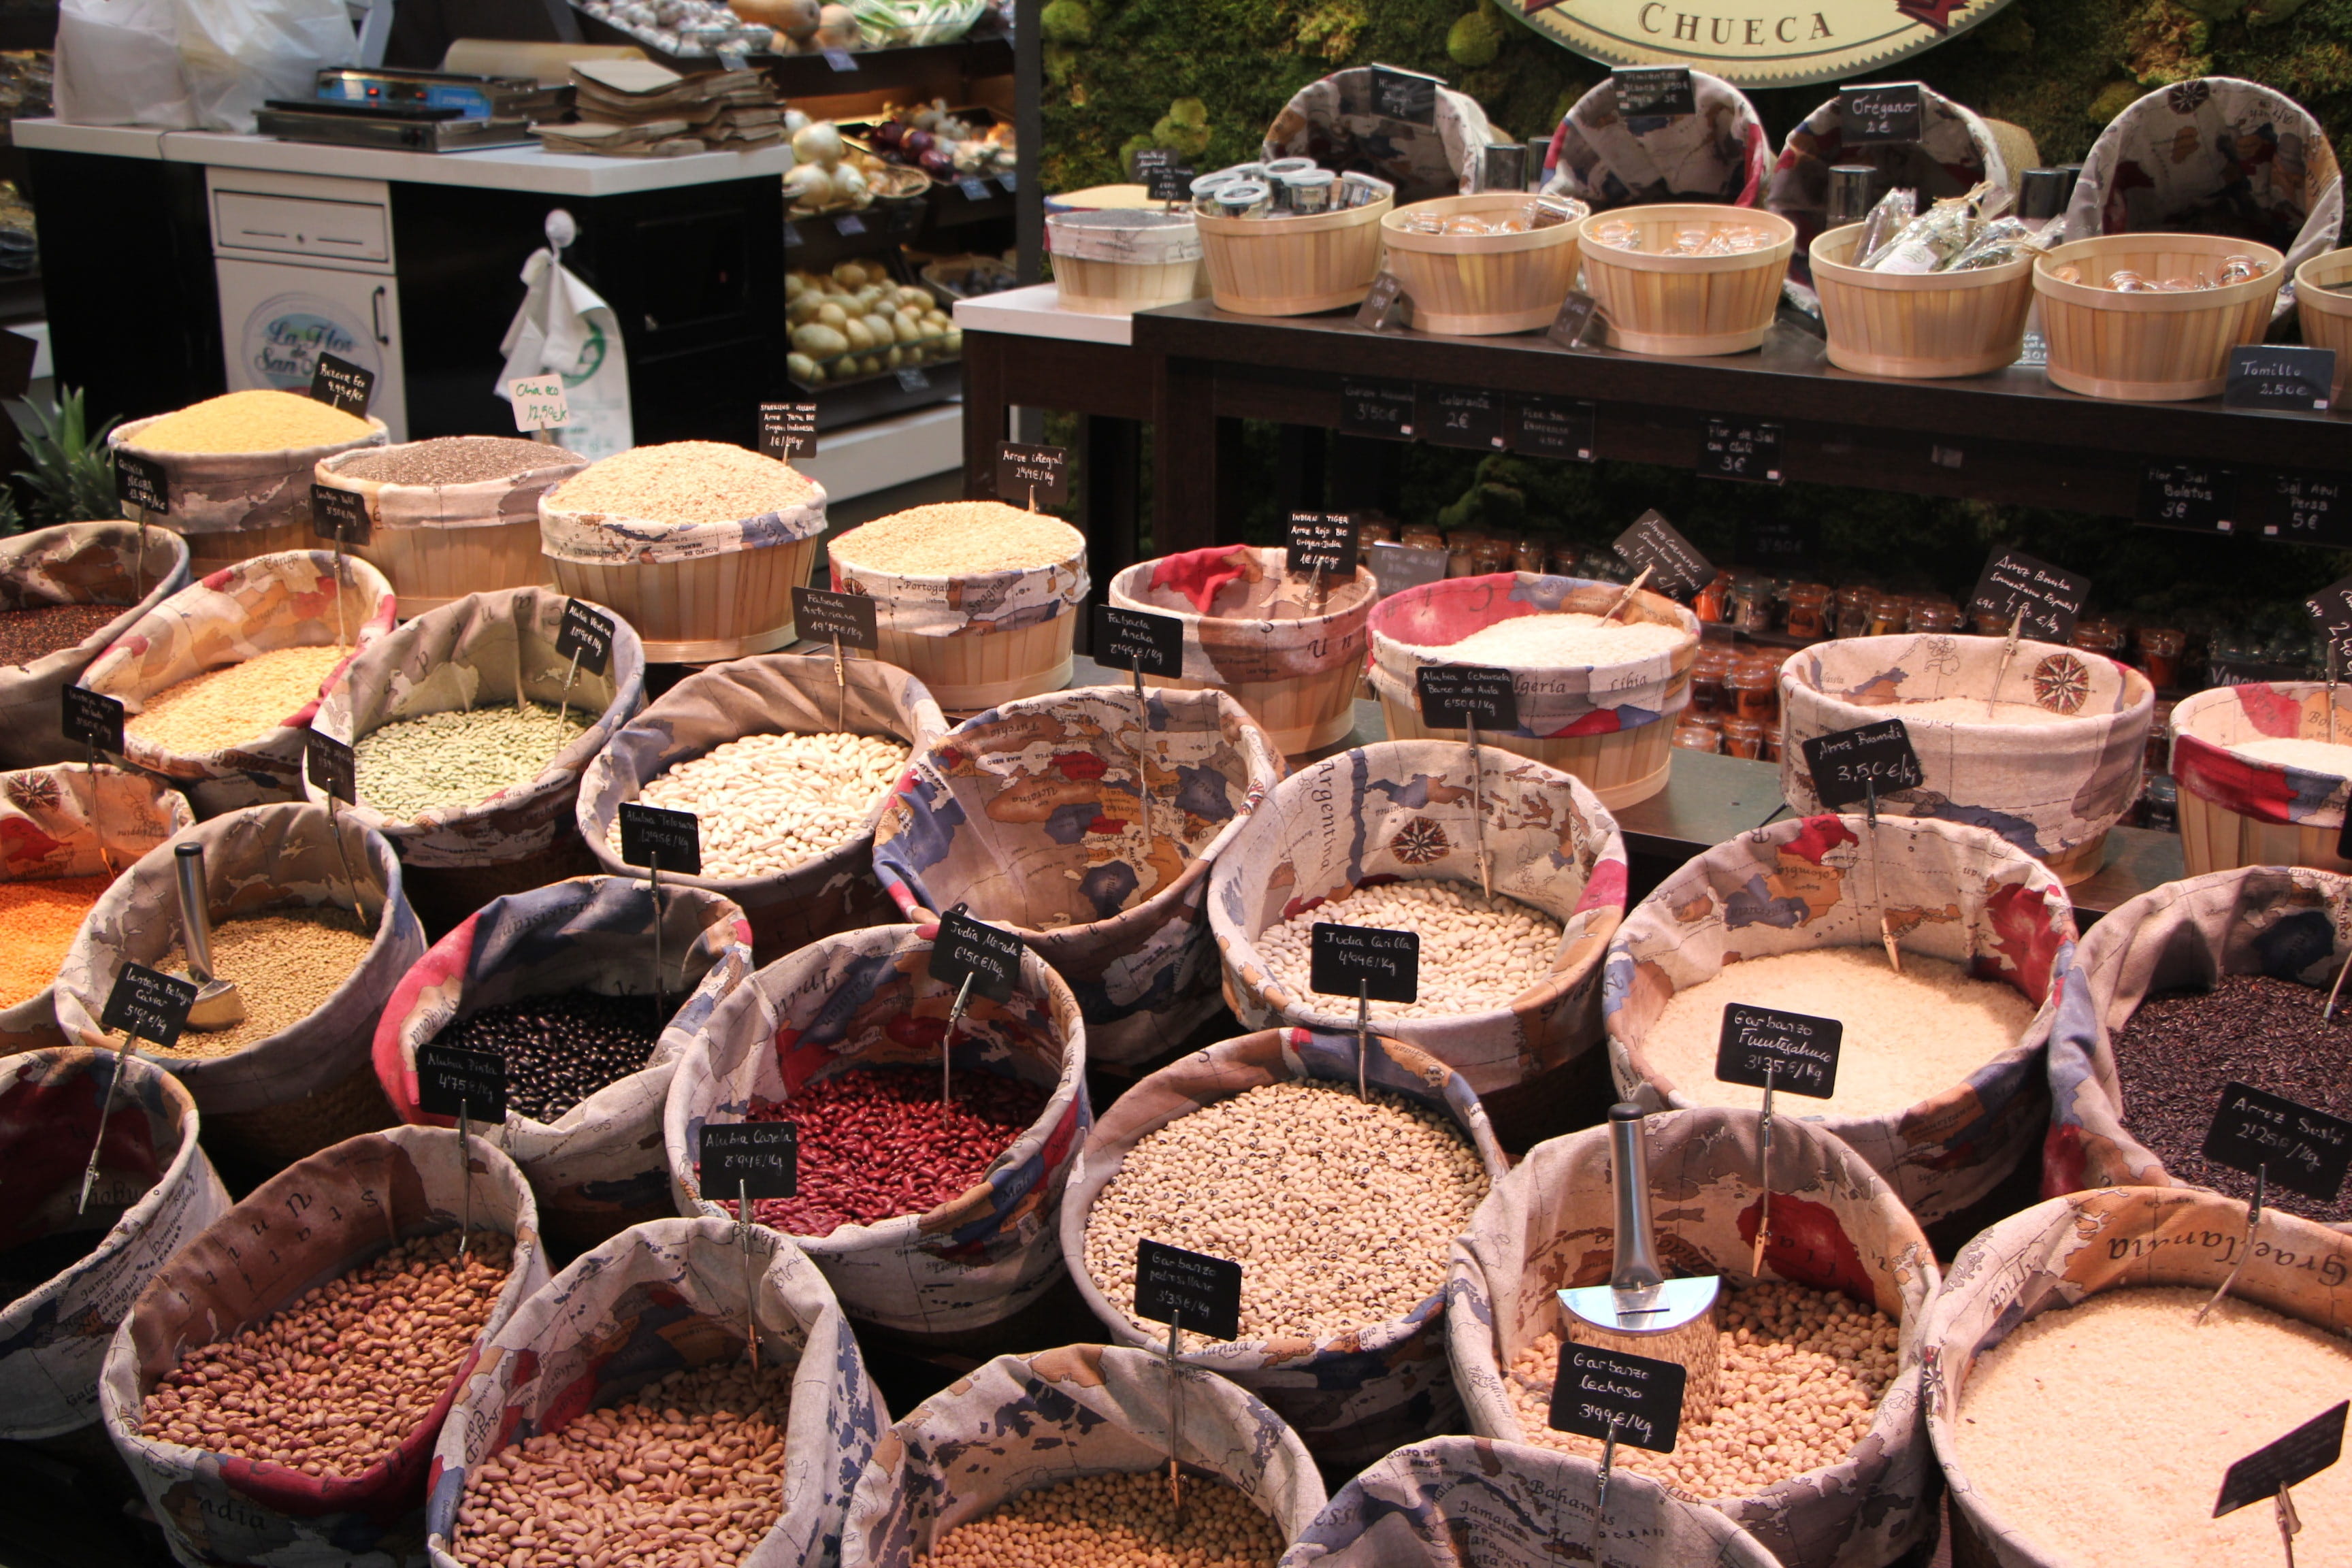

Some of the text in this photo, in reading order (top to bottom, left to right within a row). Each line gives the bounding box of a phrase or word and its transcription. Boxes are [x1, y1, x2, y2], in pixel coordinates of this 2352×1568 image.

[1638, 1, 1834, 46] CHUECA
[1852, 95, 1917, 119] Orégano
[2240, 360, 2300, 376] Tomillo
[516, 382, 542, 397] Chia
[1719, 456, 1746, 472] 3€
[2164, 484, 2212, 501] Boletus
[2161, 502, 2188, 518] 3€
[1292, 514, 1348, 524] INDIAN TIGER
[902, 580, 959, 595] Portogallo
[968, 578, 1005, 612] Spagna
[807, 593, 845, 609] Fabada
[1107, 612, 1150, 631] Fabada
[1121, 628, 1154, 644] Ancha
[1422, 671, 1458, 681] Alubia
[1427, 681, 1454, 693] Barco
[1461, 685, 1474, 693] de
[1310, 757, 1335, 872] Argentina
[982, 933, 1018, 956] Morada
[1371, 934, 1412, 950] Carilla
[125, 967, 160, 994] Lenteja
[1734, 1010, 1812, 1036] Garbanzo
[468, 1058, 497, 1075] Pinta
[2232, 1096, 2286, 1124] Arroz
[706, 1128, 791, 1147] Alubia Canela
[1152, 1251, 1218, 1277] Garbanzo
[1573, 1352, 1650, 1380] Garbanzo
